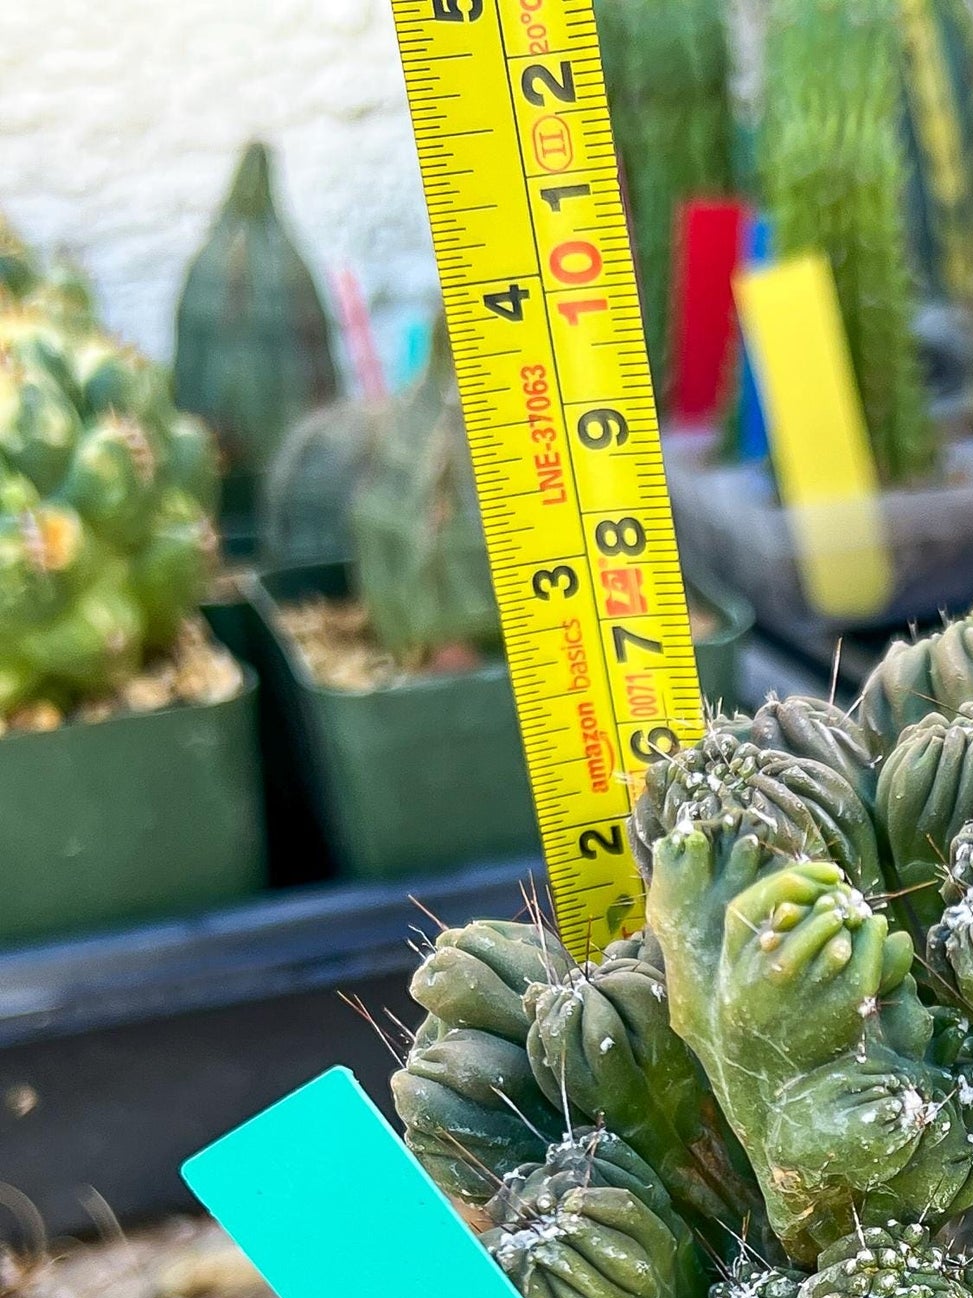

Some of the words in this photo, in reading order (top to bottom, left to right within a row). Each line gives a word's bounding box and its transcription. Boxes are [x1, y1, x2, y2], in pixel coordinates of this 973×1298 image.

[434, 0, 483, 22] 5
[521, 61, 576, 107] 2
[540, 183, 591, 212] 1
[483, 283, 530, 322] 4
[550, 241, 608, 326] 10
[521, 364, 567, 505] LNE-37063
[577, 408, 630, 450] 9
[595, 517, 647, 556] 8
[532, 565, 579, 601] 3
[562, 618, 591, 691] basics
[612, 626, 664, 664] 7
[625, 673, 659, 718] 0071
[576, 702, 610, 793] amazon
[630, 725, 681, 764] 6
[579, 825, 624, 860] 2
